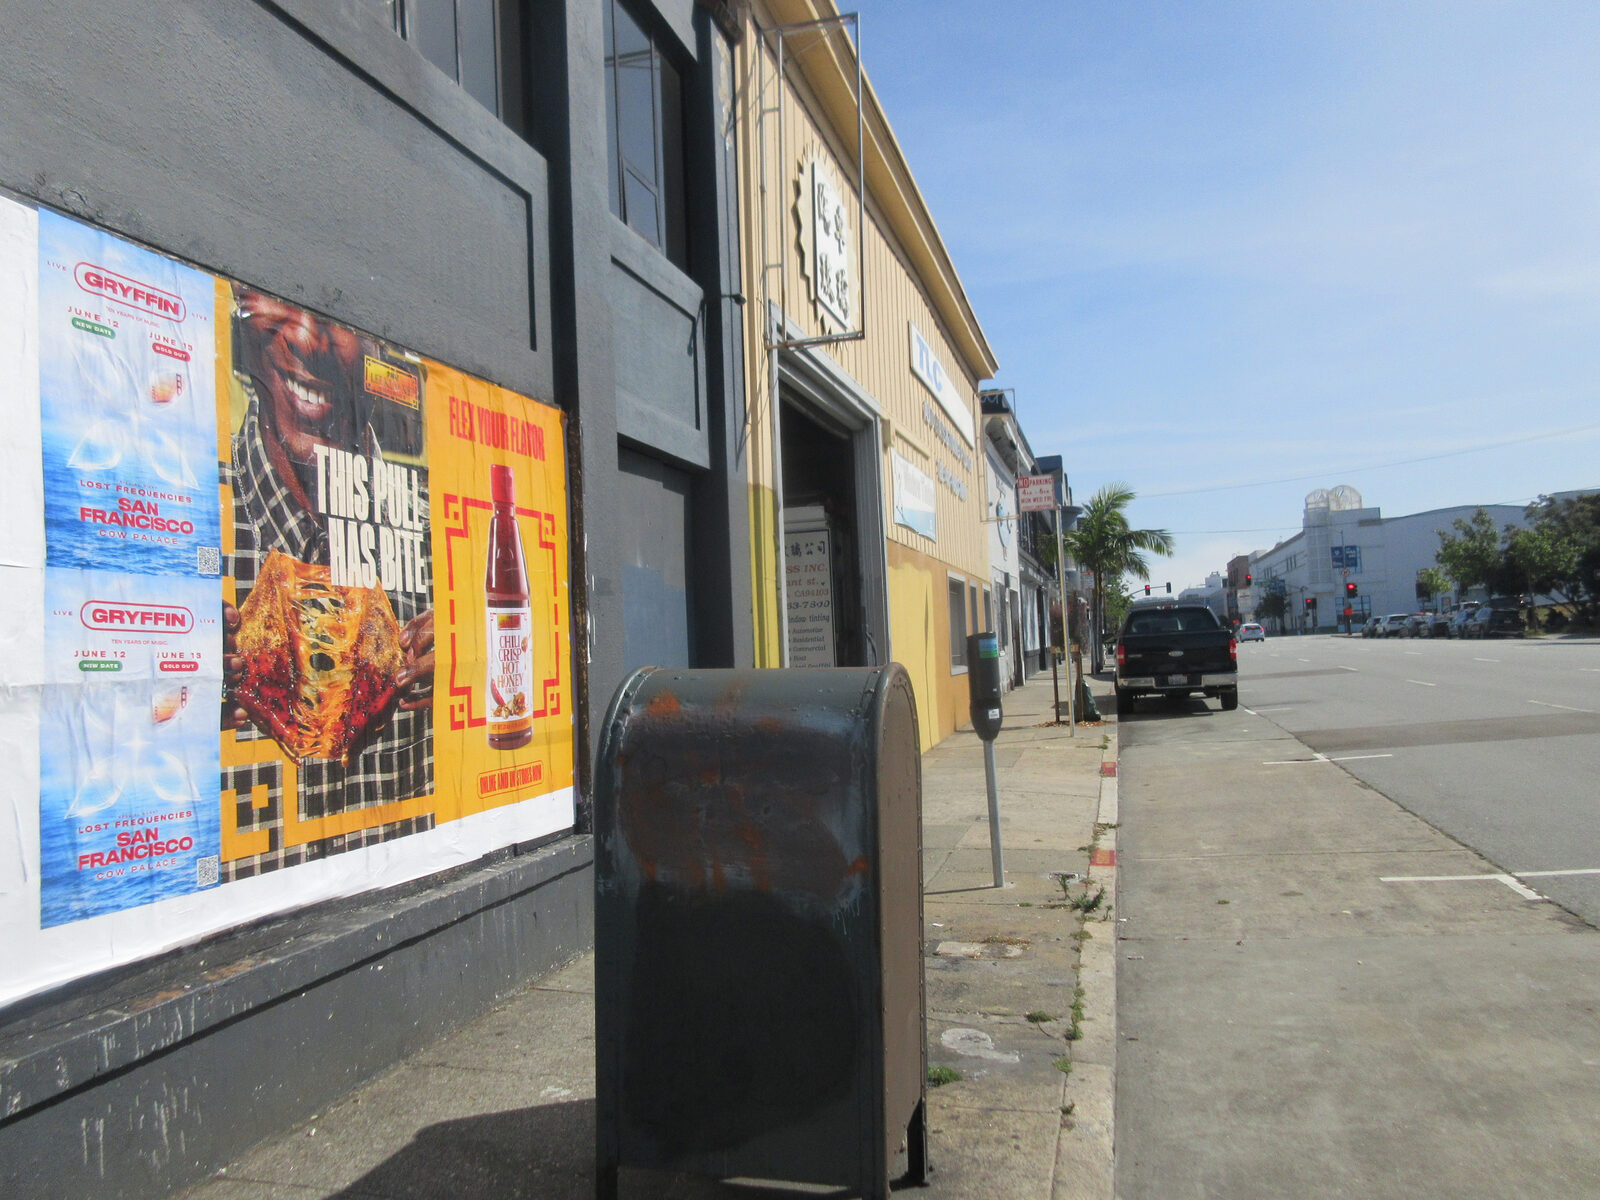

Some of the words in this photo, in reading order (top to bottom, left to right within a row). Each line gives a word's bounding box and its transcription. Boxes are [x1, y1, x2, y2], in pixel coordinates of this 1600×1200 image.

[47, 260, 67, 271] LIVE
[84, 272, 180, 316] GRYFFIN
[67, 306, 101, 321] JUNE
[107, 318, 119, 328] 12
[75, 319, 92, 330] NEW
[94, 325, 112, 336] DATE
[149, 332, 177, 345] JUNE
[155, 345, 173, 355] SOLD
[174, 350, 187, 359] OUT
[916, 333, 943, 393] TLC
[449, 395, 477, 442] FLEX
[477, 406, 510, 451] YOUR
[510, 415, 546, 462] FLAVOR
[80, 480, 111, 490] LOST
[115, 485, 193, 503] FREQUENCIES
[313, 442, 370, 522] THIS
[373, 456, 423, 532] PULL
[1019, 477, 1029, 488] NO
[1030, 476, 1053, 486] PARKING
[118, 497, 159, 516] SAN
[80, 507, 194, 534] FRANCISCO
[99, 529, 127, 539] COW
[133, 534, 179, 545] PALACE
[327, 516, 377, 590] HAS
[379, 525, 427, 594] BITE
[786, 564, 801, 573] SS
[804, 563, 828, 573] INC.
[786, 578, 802, 586] ant
[92, 608, 186, 627] GRYFFIN
[788, 615, 807, 623] indow
[809, 613, 830, 623] tinting
[499, 635, 521, 648] CHILI
[74, 650, 106, 658] JUNE
[498, 649, 522, 662] CRISP
[502, 661, 520, 674] HOT
[497, 673, 524, 688] HONEY
[497, 772, 509, 790] AND
[510, 770, 516, 788] IN
[516, 767, 533, 786] STORES
[78, 823, 110, 834] LOST
[114, 811, 193, 828] FREQUENCIES
[117, 827, 159, 847] SAN
[78, 836, 193, 871] FRANCISCO
[96, 868, 125, 880] COW
[131, 858, 177, 873] PALACE
